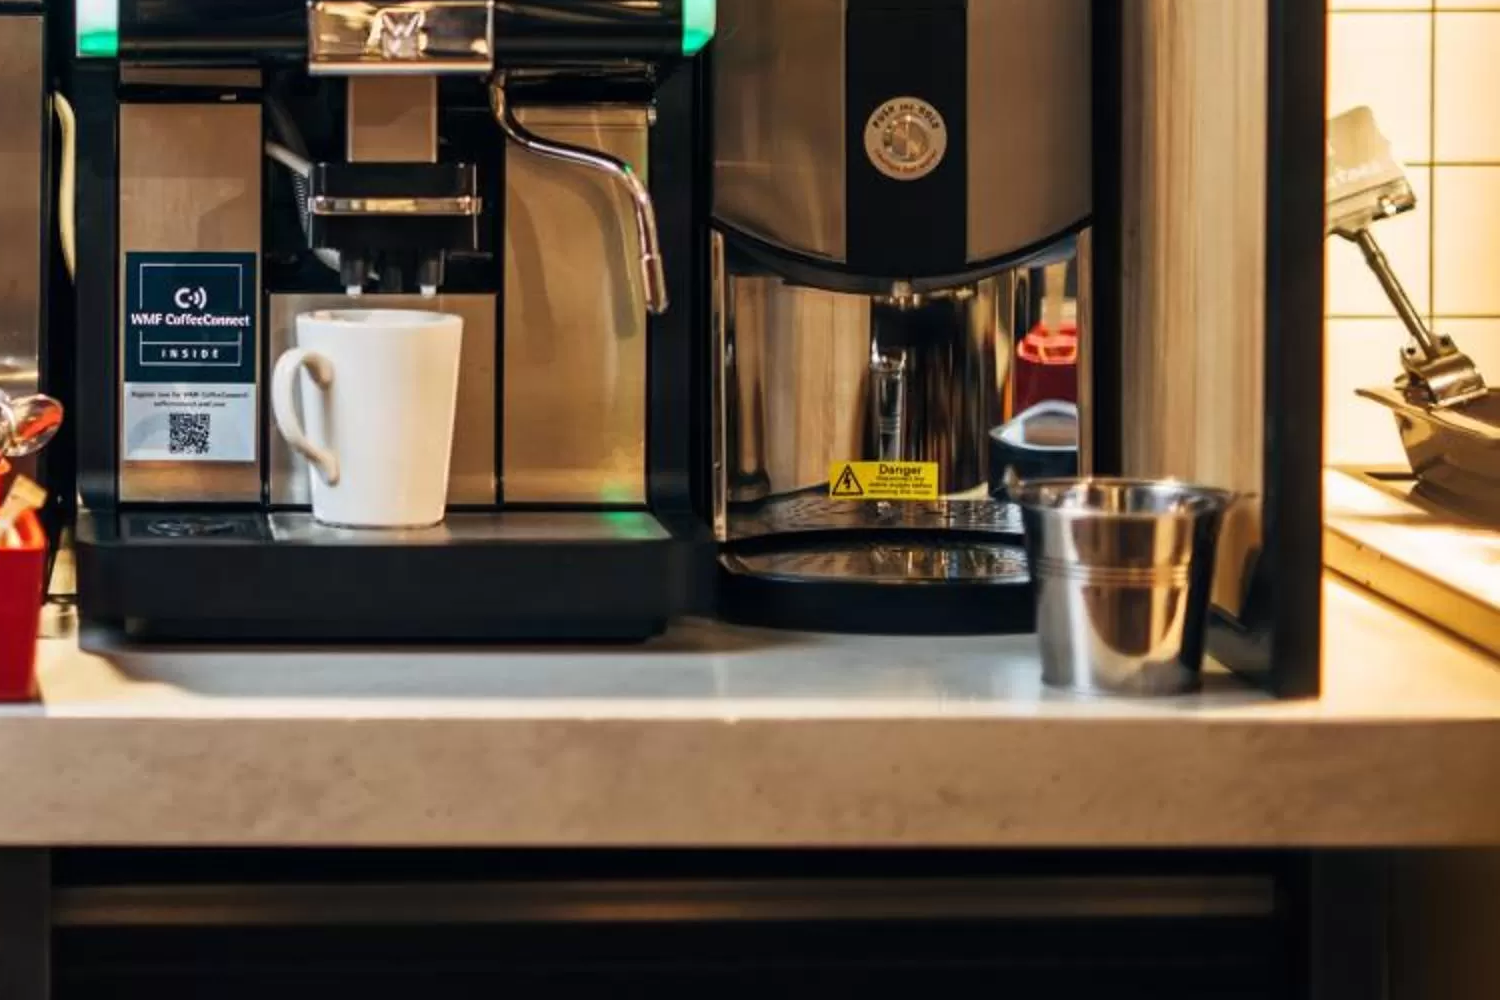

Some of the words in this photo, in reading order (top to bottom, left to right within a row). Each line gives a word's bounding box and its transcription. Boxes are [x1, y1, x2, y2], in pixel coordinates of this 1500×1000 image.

[131, 313, 162, 325] WMF
[165, 313, 251, 327] CoffeeConnect
[161, 348, 219, 359] INSIDE
[879, 464, 922, 476] Danger
